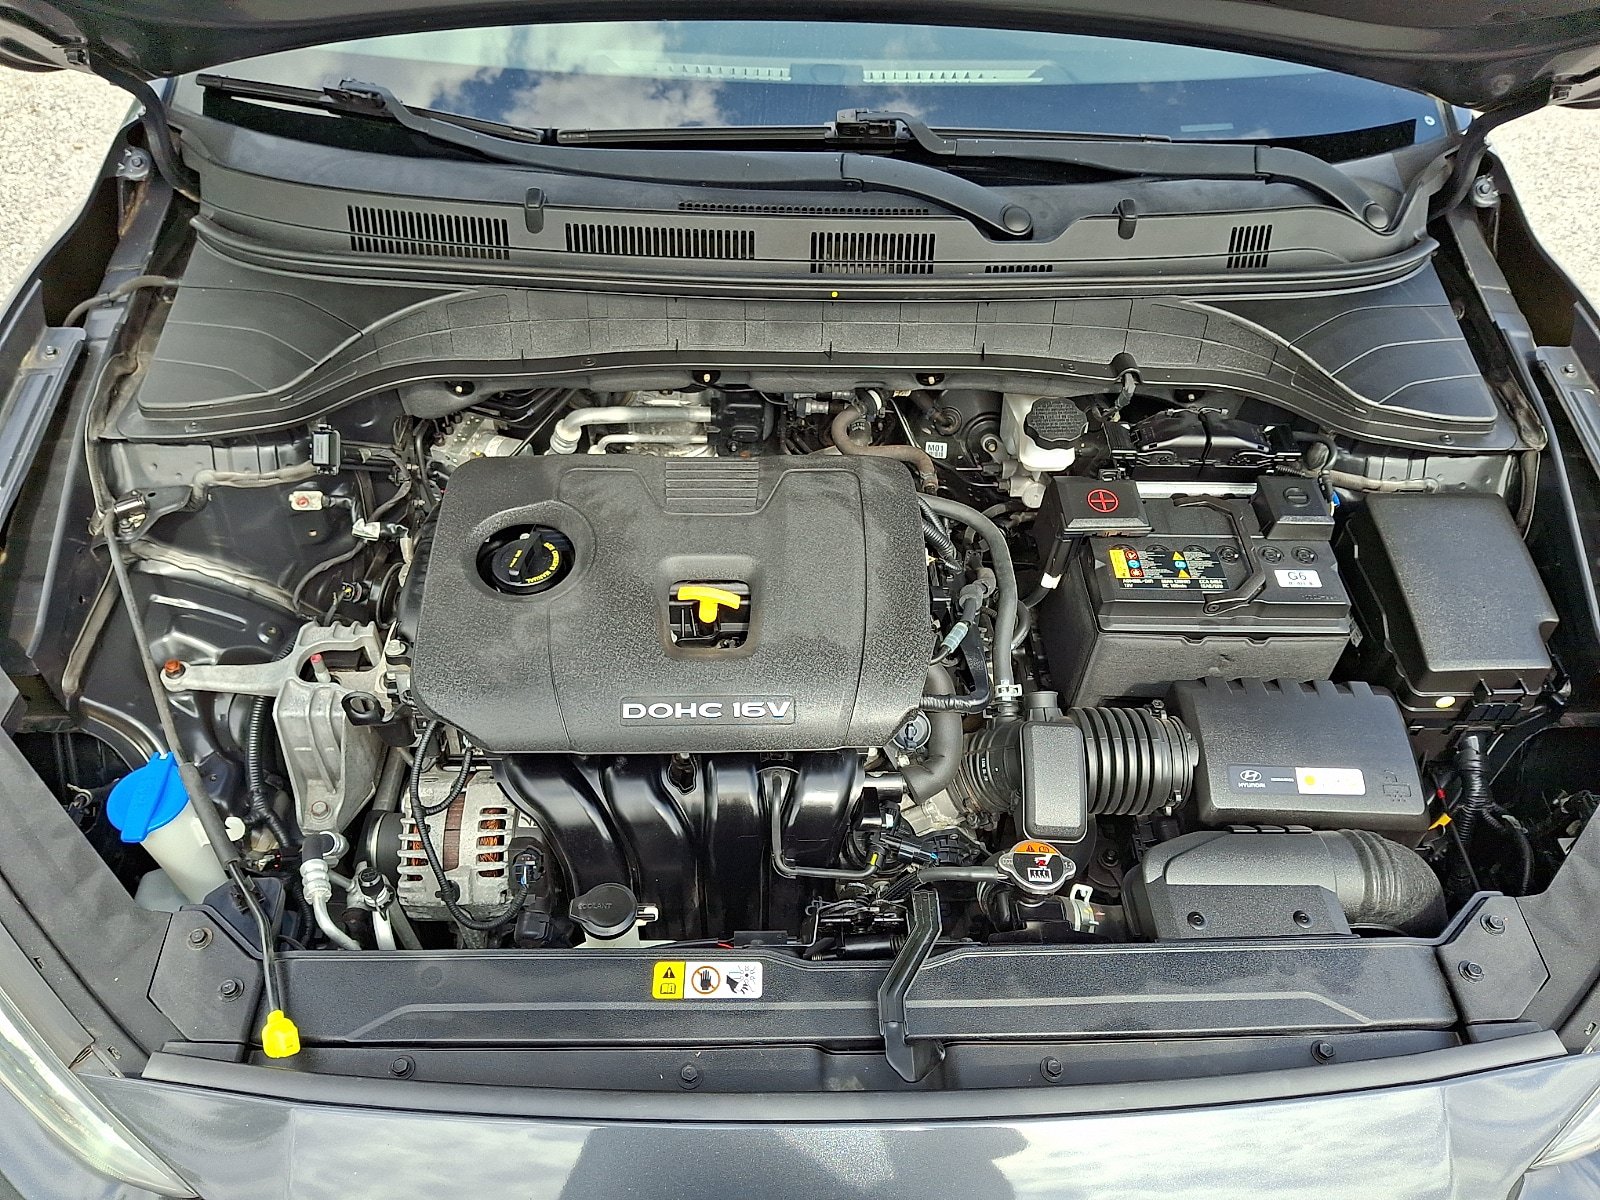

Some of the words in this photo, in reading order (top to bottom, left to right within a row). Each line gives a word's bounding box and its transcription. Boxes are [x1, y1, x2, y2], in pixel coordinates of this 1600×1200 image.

[1287, 571, 1307, 580] G6
[622, 702, 723, 719] DOHC
[732, 701, 791, 718] 16V
[577, 902, 612, 910] COOLANT
